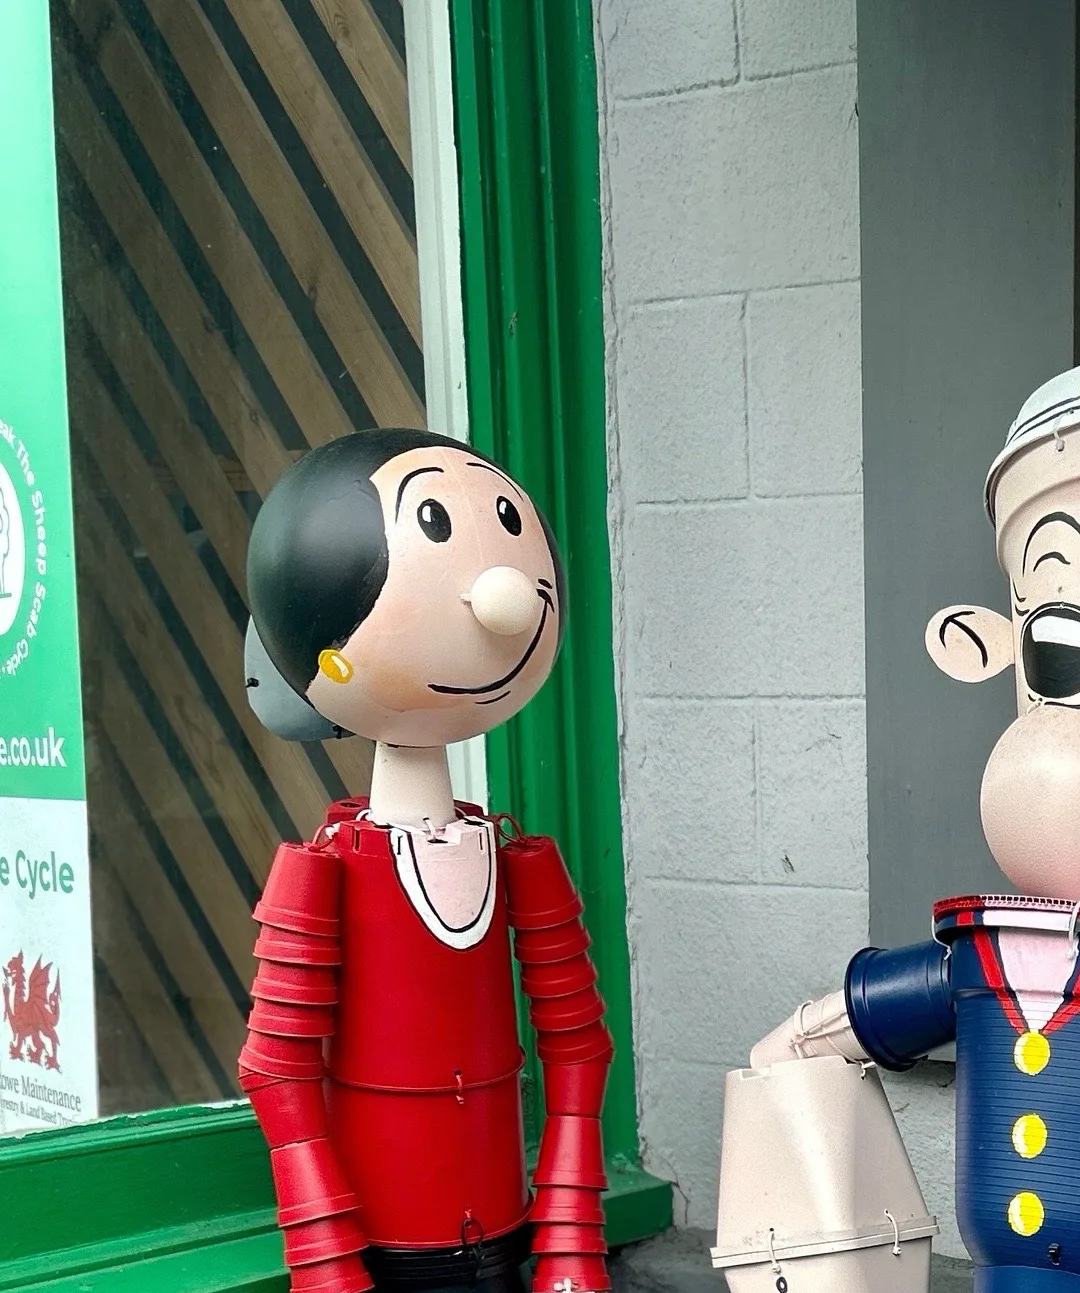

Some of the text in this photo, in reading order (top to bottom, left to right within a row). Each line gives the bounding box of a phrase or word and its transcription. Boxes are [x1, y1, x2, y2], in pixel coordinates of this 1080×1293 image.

[31, 490, 47, 576] Sheep
[15, 849, 75, 900] Cycle
[21, 1074, 82, 1112] Maintenance
